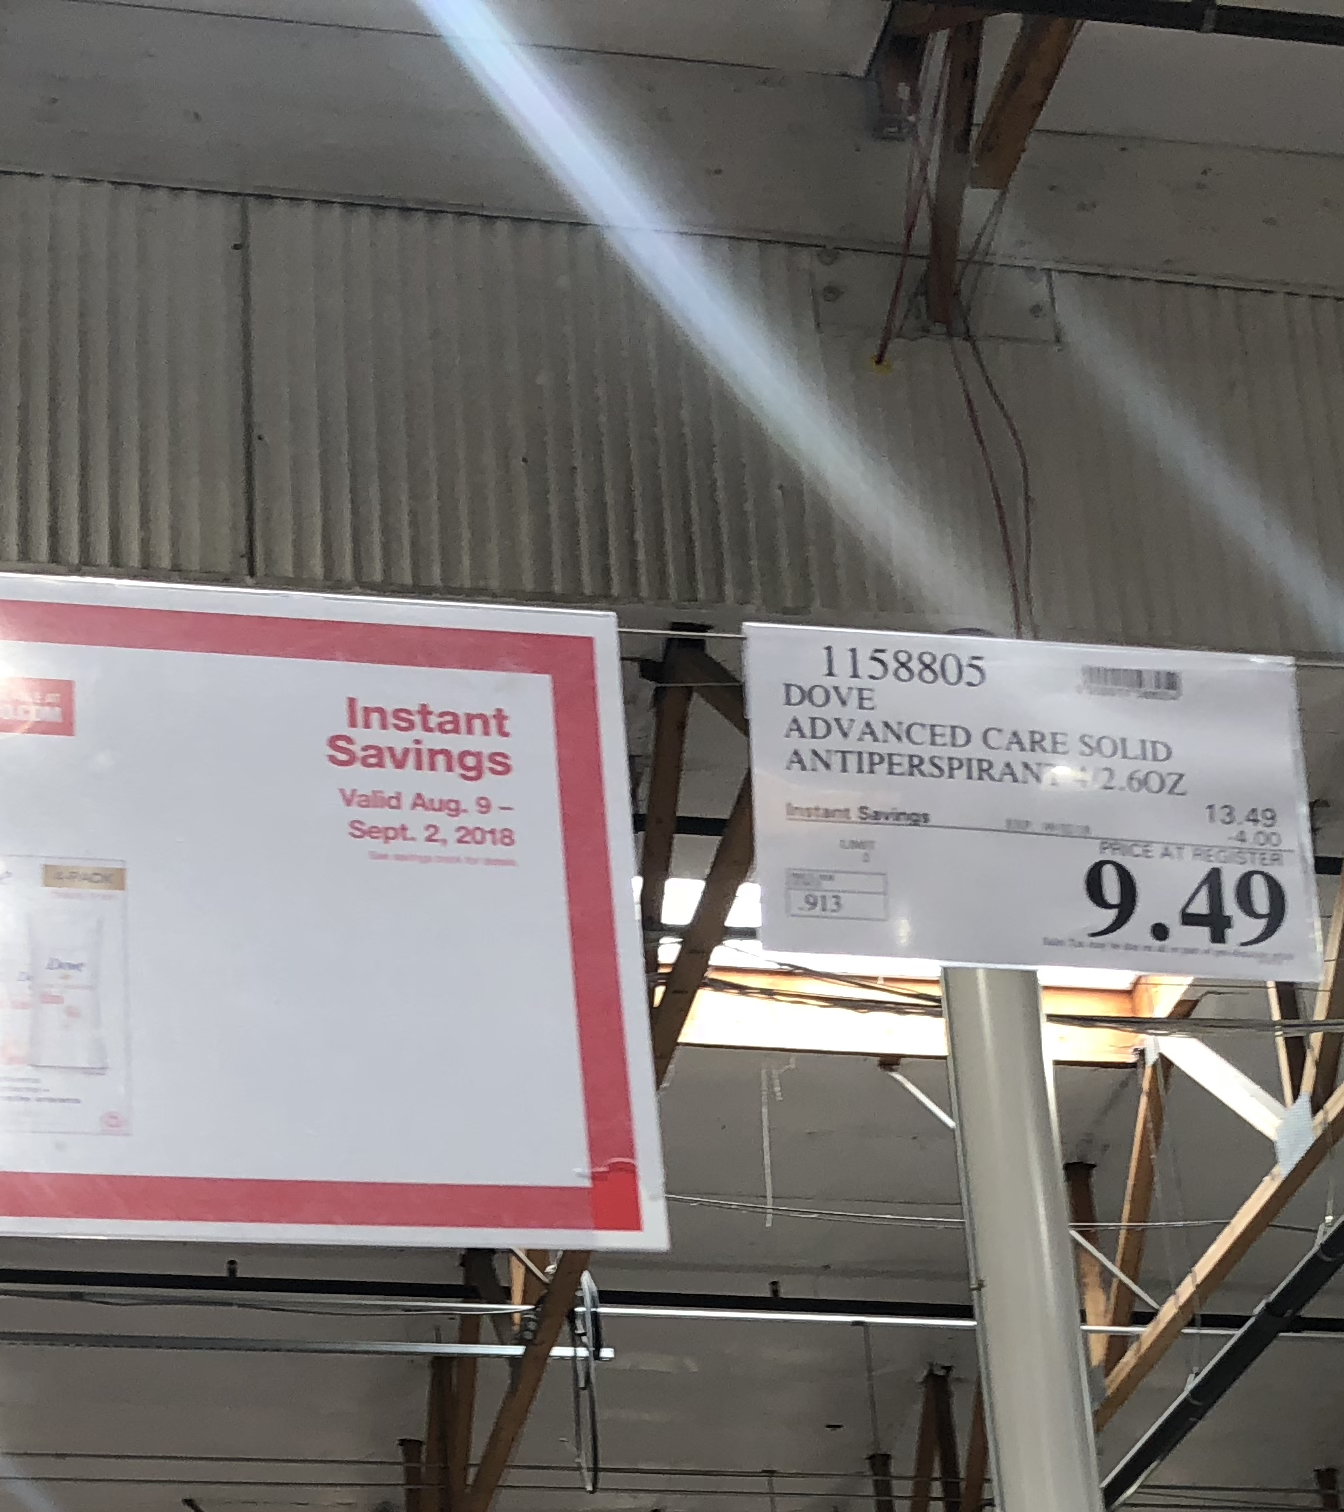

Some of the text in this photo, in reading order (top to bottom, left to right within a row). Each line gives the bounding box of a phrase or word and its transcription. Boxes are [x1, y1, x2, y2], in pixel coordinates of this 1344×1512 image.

[823, 645, 987, 687] 1158805
[783, 682, 877, 711] DOVE
[346, 697, 511, 738] Instant
[783, 715, 1173, 762] ADVANCED CARE SOLID
[326, 734, 513, 781] Savings
[338, 787, 402, 810] Valid
[410, 792, 468, 817] Aug.
[476, 796, 492, 814] 9
[786, 802, 931, 827] Instant Savings
[1205, 803, 1277, 828] 13.49
[348, 820, 516, 847] Sept. 2, 2018
[1228, 830, 1283, 847] -4.00
[1099, 841, 1284, 867] PRICE AT REGISTER
[1084, 859, 1287, 947] 9.49
